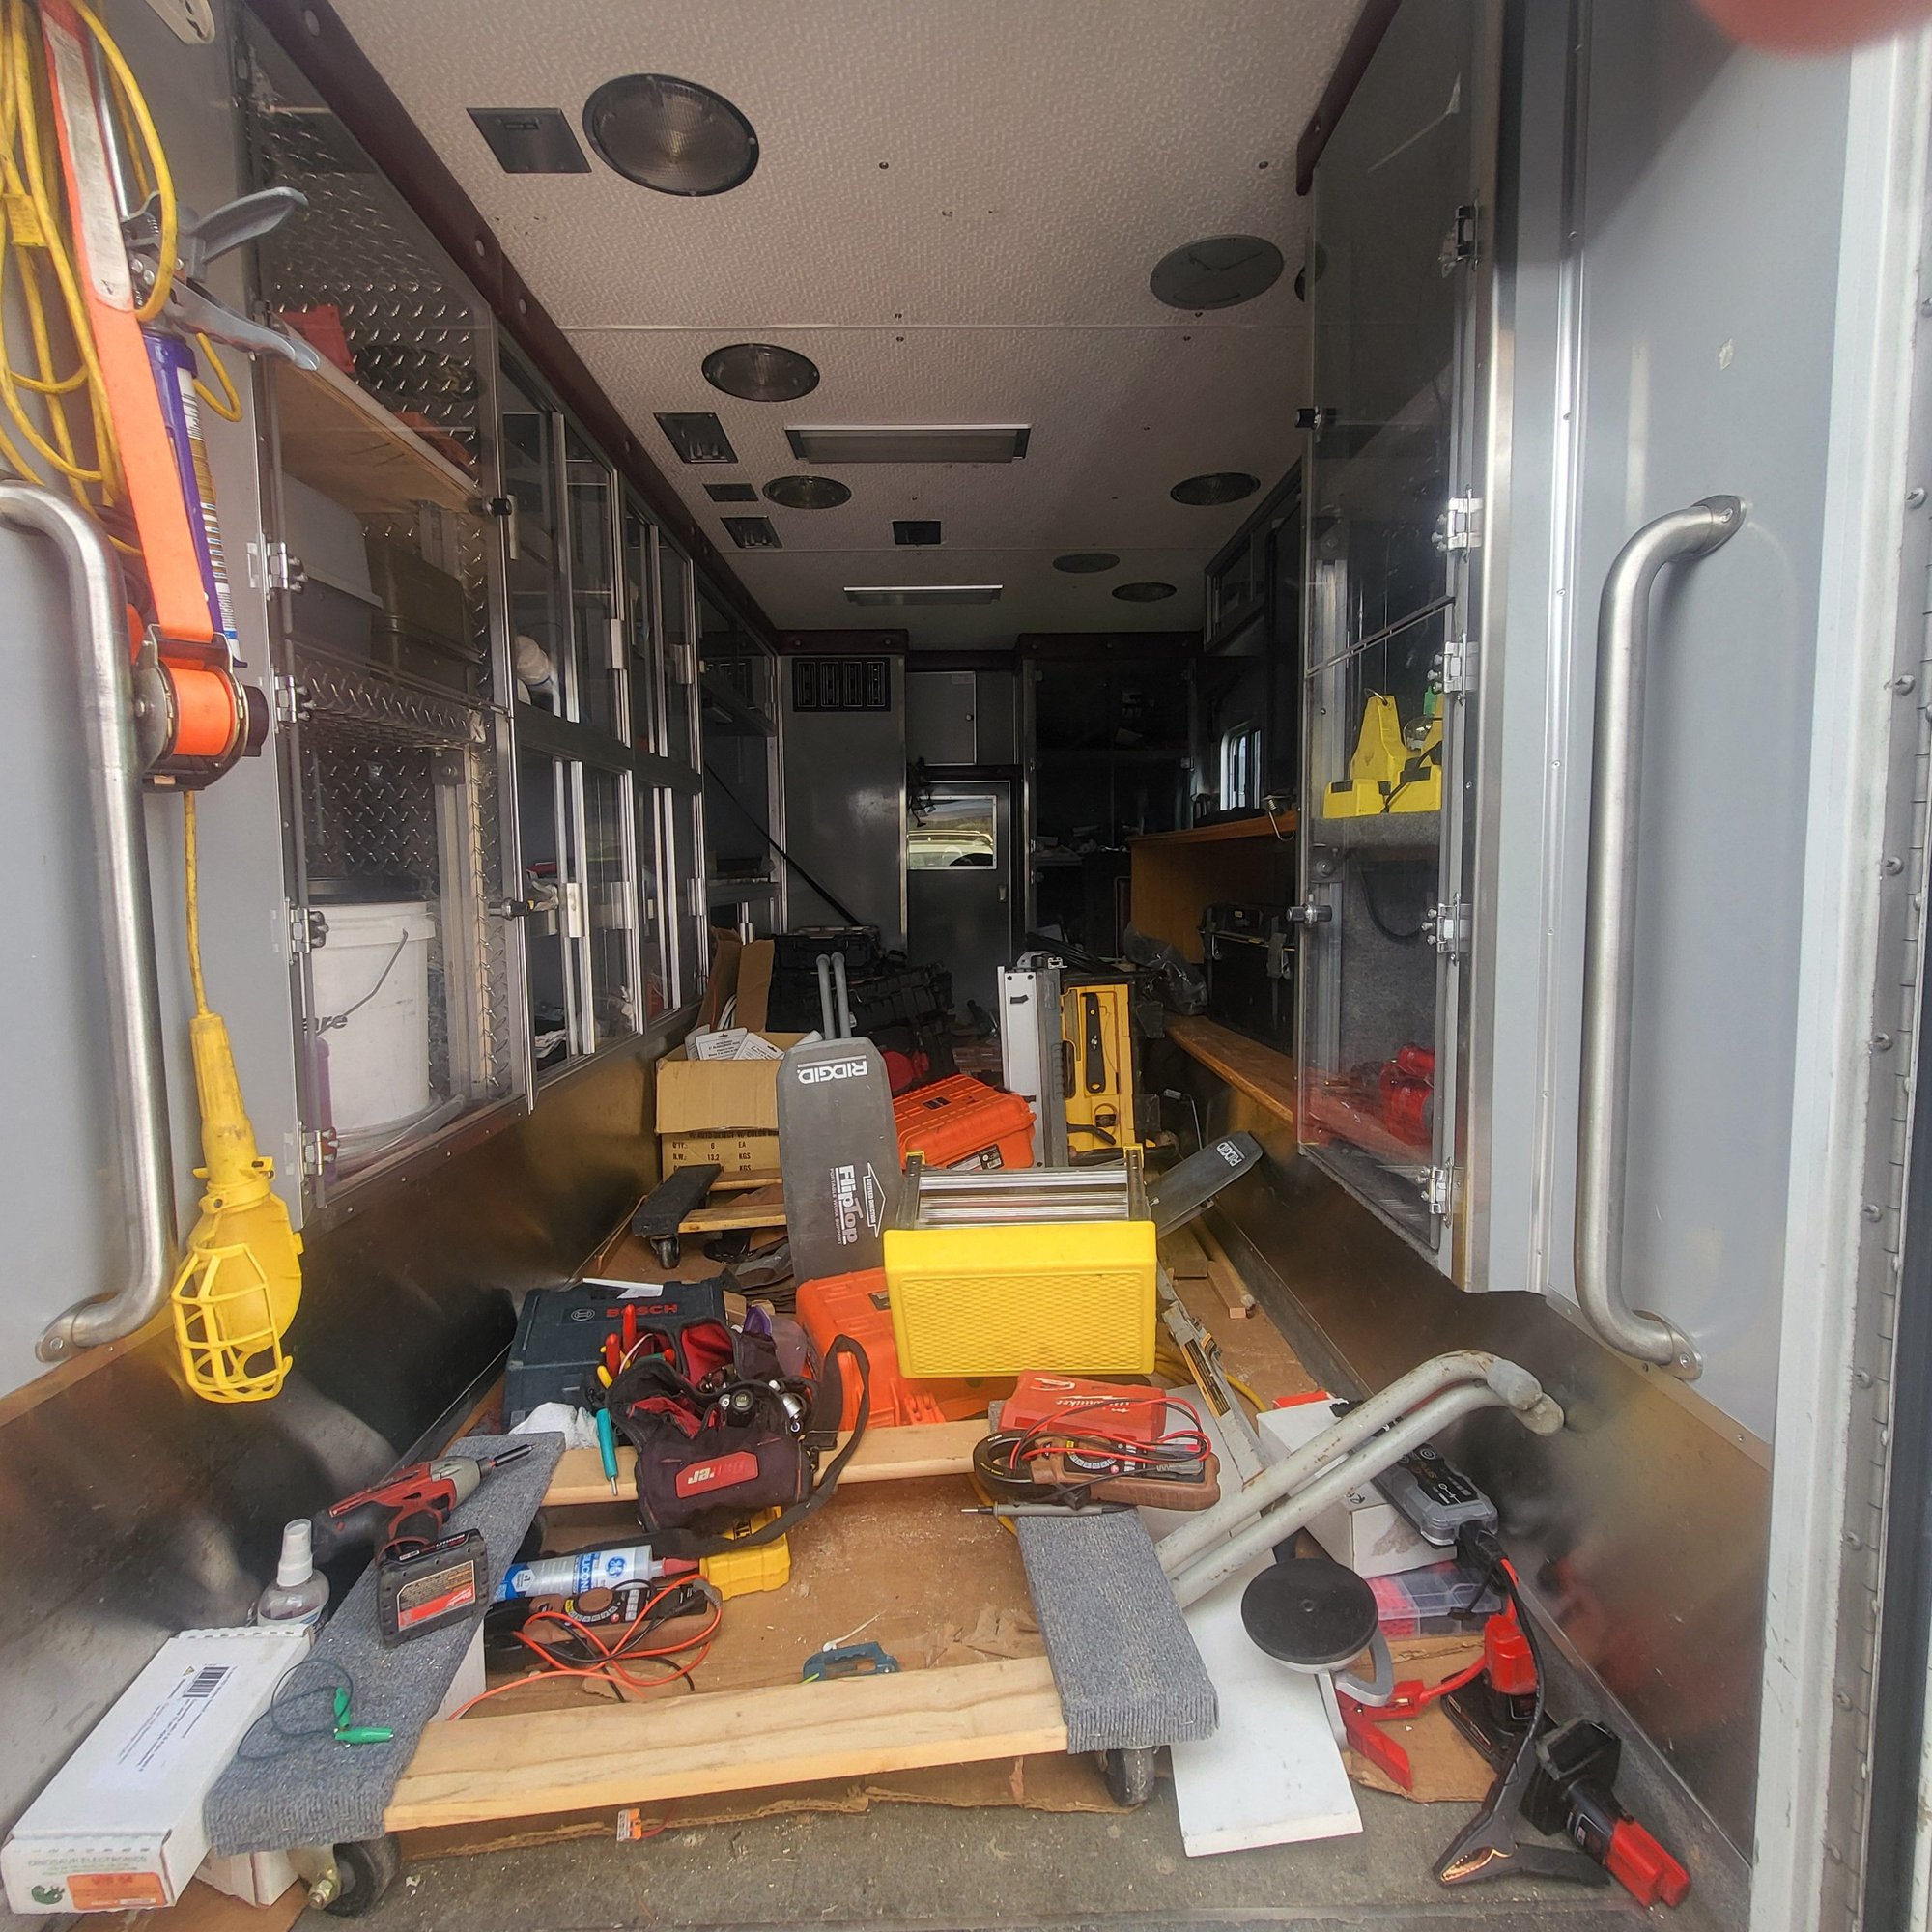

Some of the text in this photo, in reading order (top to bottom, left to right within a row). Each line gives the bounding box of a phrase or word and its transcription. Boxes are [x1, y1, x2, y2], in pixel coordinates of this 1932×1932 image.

[798, 1060, 867, 1084] RIDGID
[838, 1165, 863, 1243] FlipTop
[606, 1304, 678, 1318] BSCH
